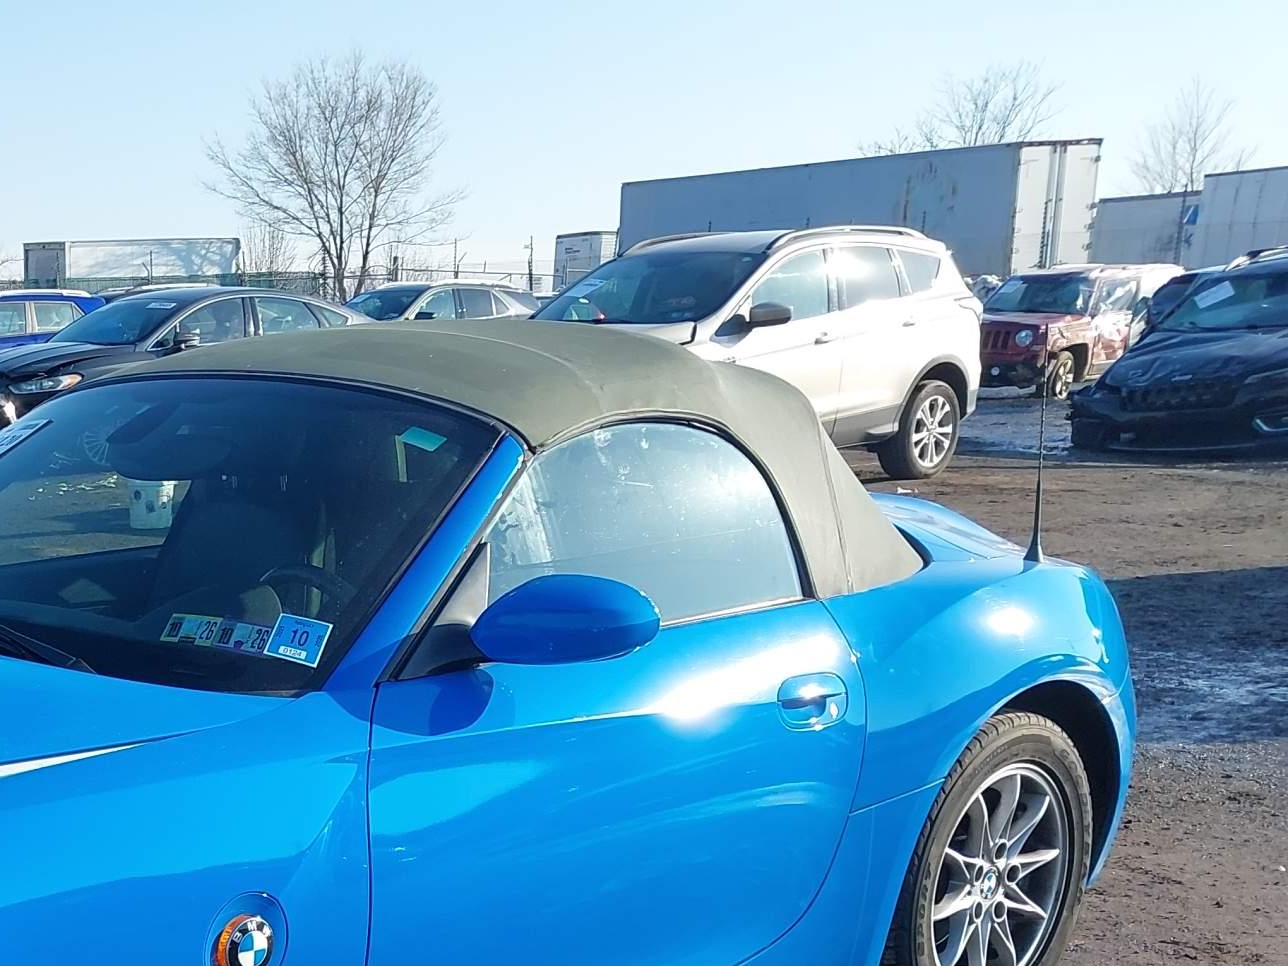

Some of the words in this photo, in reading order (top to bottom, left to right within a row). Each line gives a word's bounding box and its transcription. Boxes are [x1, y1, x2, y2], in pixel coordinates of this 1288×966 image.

[168, 621, 182, 638] 10
[199, 620, 218, 641] 26
[218, 627, 234, 645] 10
[250, 628, 271, 650] 26
[289, 628, 310, 647] 10
[233, 920, 272, 943] BMW
